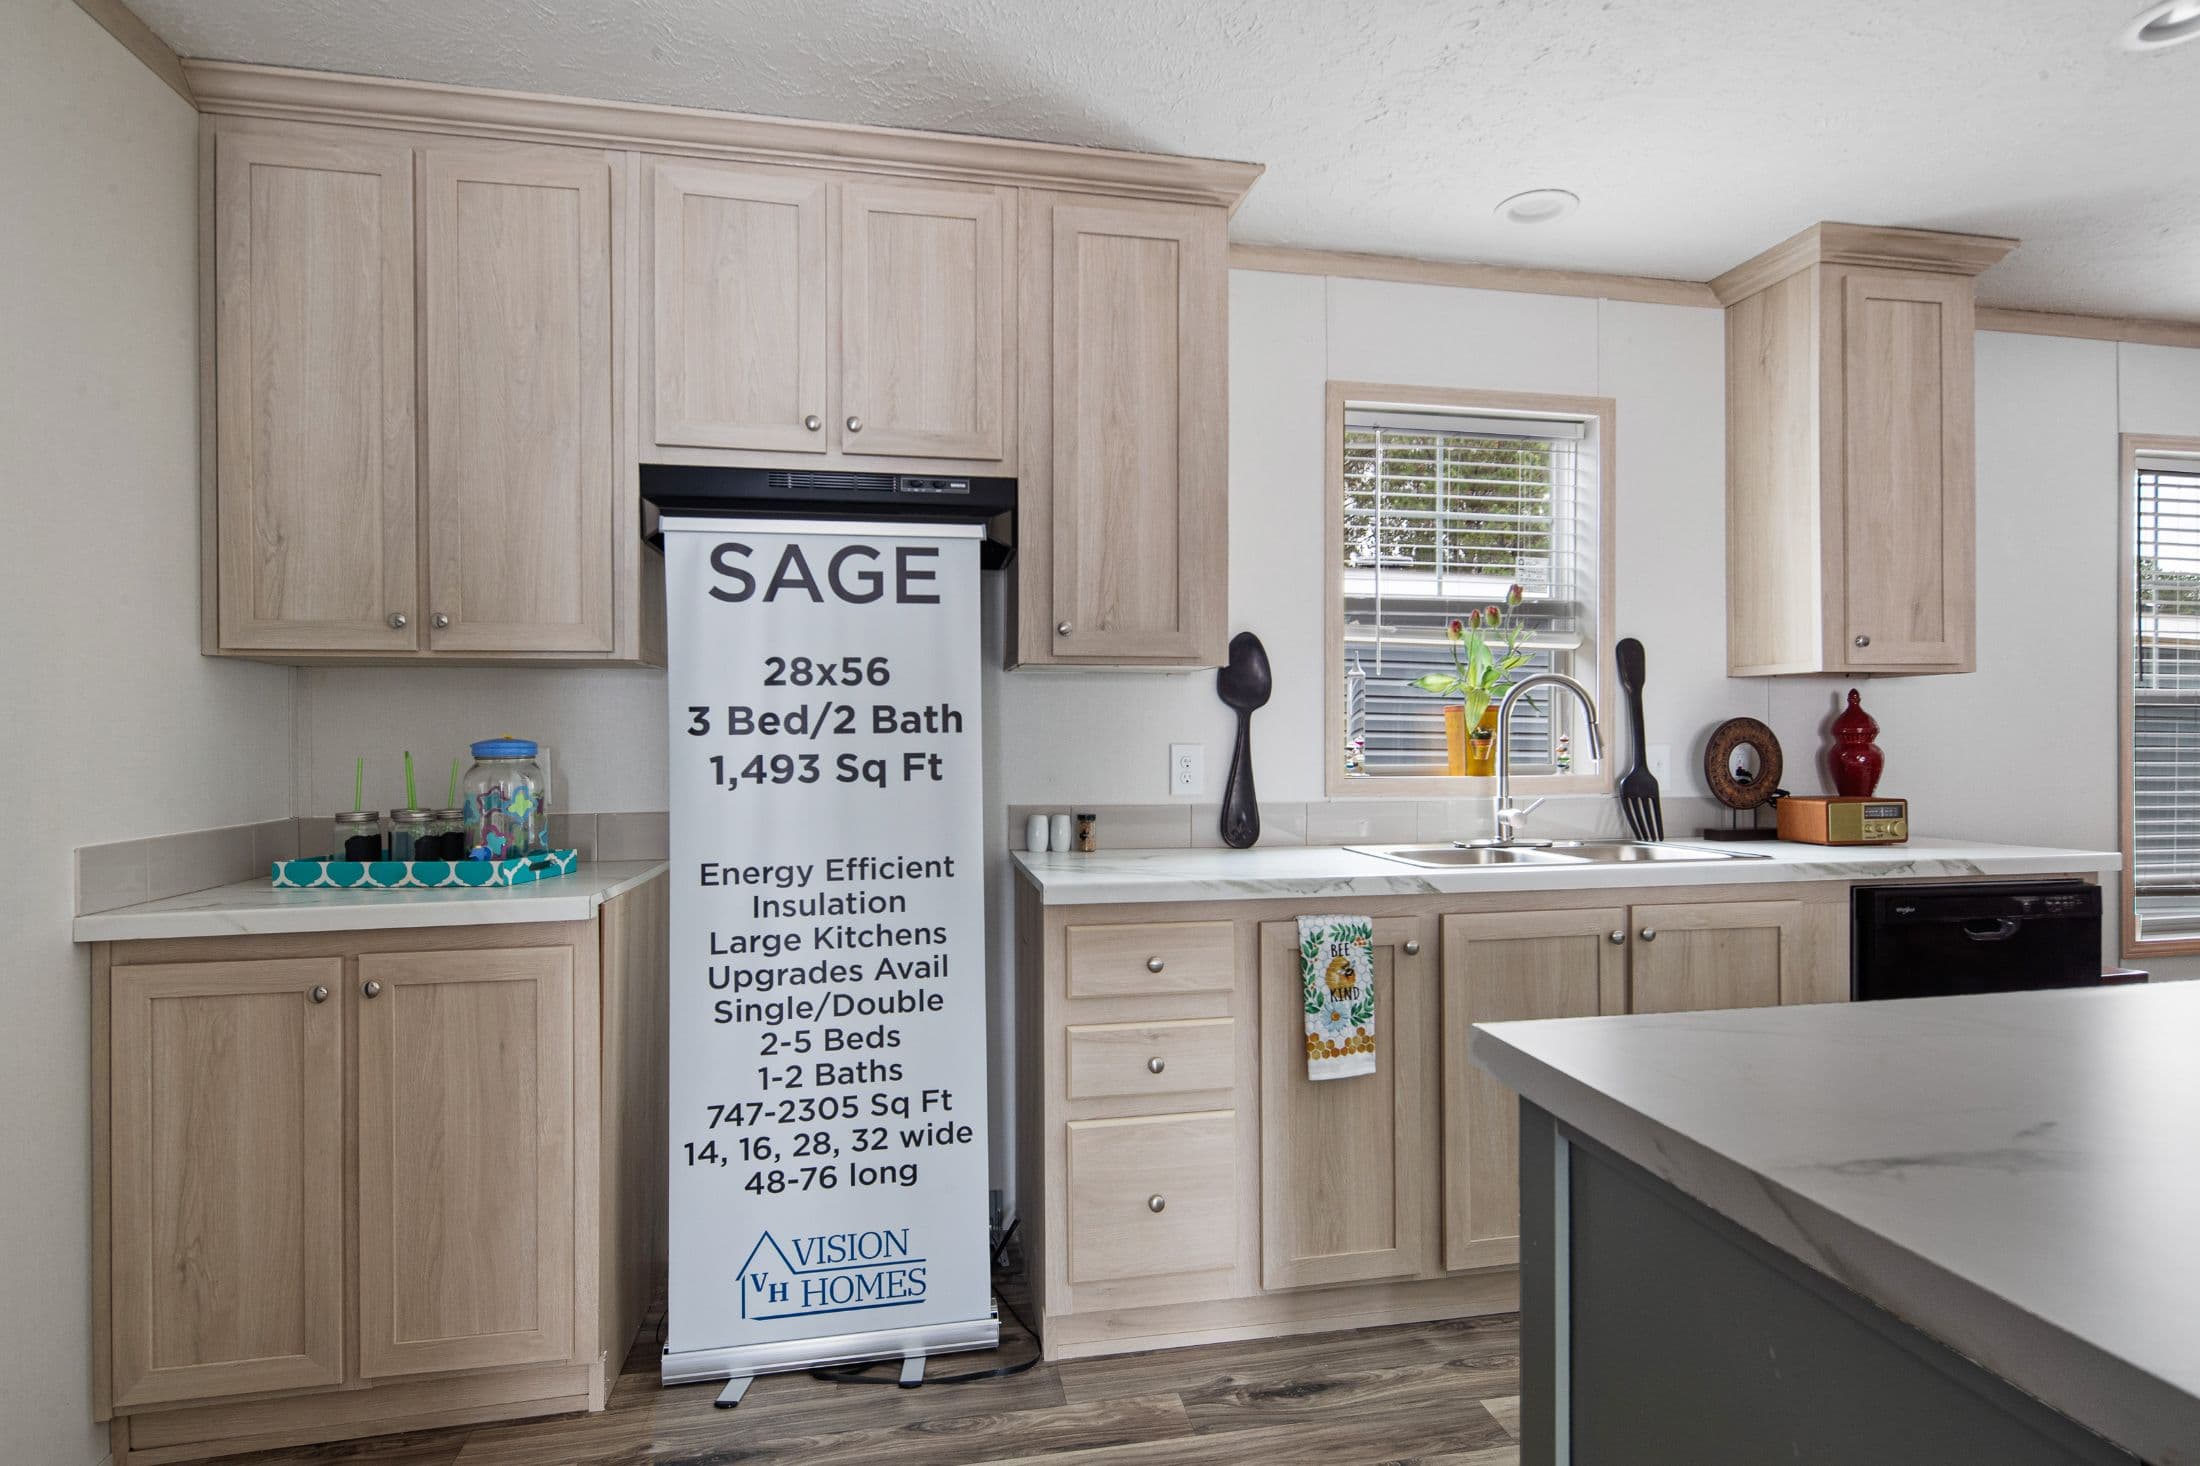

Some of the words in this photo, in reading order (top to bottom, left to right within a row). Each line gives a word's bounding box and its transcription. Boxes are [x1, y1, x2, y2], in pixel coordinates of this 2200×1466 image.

[709, 543, 940, 604] SAGE
[764, 657, 890, 686] 28x56
[688, 707, 710, 736] 3
[729, 702, 855, 739] Bed/2
[873, 704, 962, 733] Bath
[710, 754, 819, 791] 1,493
[837, 754, 886, 788] Sq
[904, 753, 942, 781] Ft
[701, 863, 813, 888] Energy
[827, 856, 954, 881] Efficient
[754, 891, 905, 918] Insulation
[711, 932, 801, 957] Large
[815, 924, 946, 949] Kitchens
[1331, 943, 1350, 958] BEE
[708, 961, 862, 991] Upgrades
[875, 954, 947, 980] Avail
[714, 989, 943, 1025] Single/Double
[1330, 986, 1360, 1003] KIND
[761, 1030, 811, 1055] 2-5
[825, 1025, 900, 1051] Beds
[758, 1065, 802, 1090] 1-2
[816, 1059, 902, 1086] Baths
[707, 1096, 859, 1129] 747-2305
[871, 1093, 908, 1119] Sq
[923, 1090, 952, 1112] Ft
[684, 1141, 727, 1167] 14,
[740, 1137, 780, 1163] 16,
[793, 1132, 839, 1158] 28,
[852, 1127, 888, 1152] 32
[900, 1121, 972, 1148] wide
[745, 1166, 837, 1194] 48-76
[851, 1163, 917, 1186] long
[792, 1229, 910, 1264] VISION
[800, 1268, 927, 1307] HOMES
